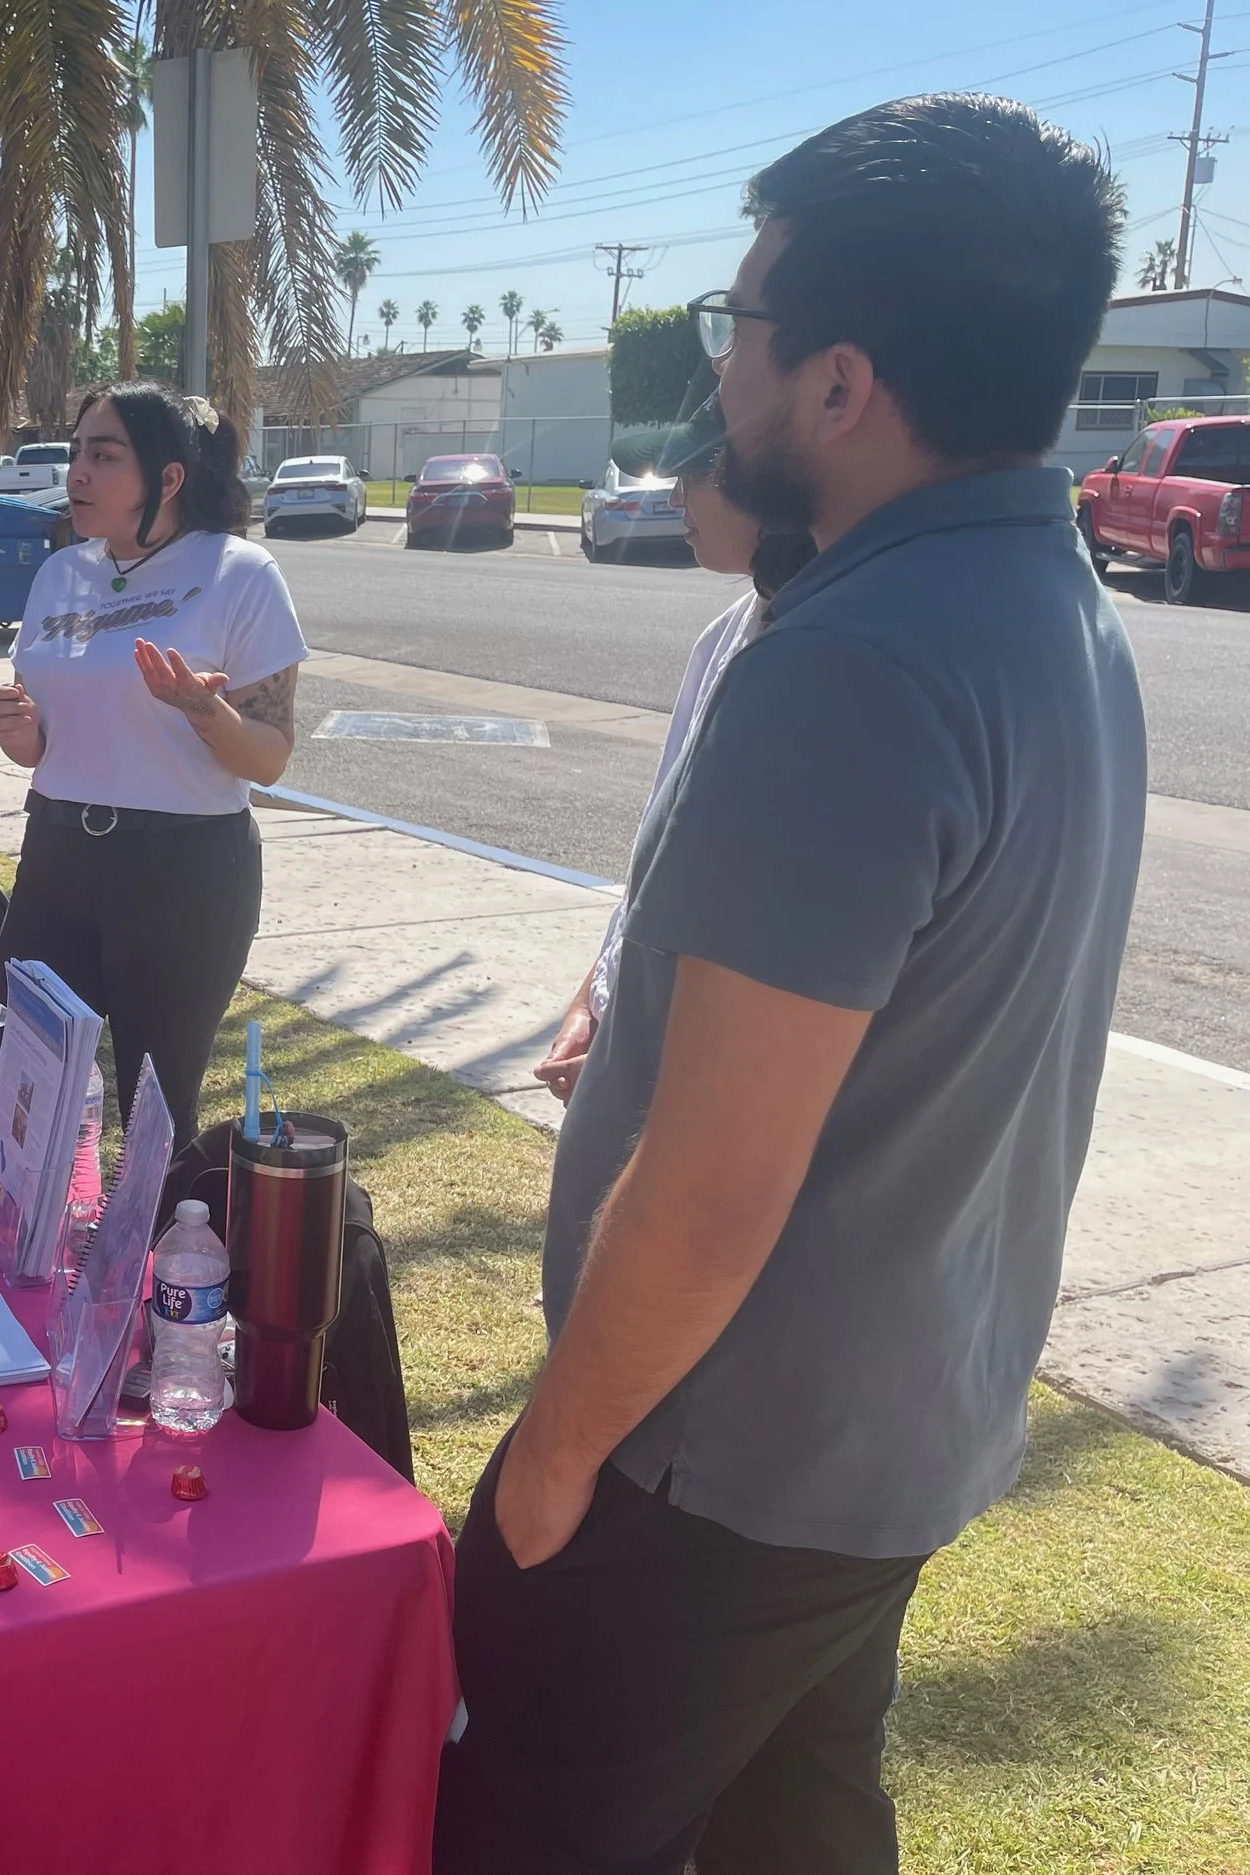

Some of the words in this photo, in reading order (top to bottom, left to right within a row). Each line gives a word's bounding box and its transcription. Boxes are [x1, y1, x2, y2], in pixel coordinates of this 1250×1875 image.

[101, 594, 141, 610] TOGETHER
[160, 1282, 186, 1299] Pure
[162, 1297, 182, 1310] Life
